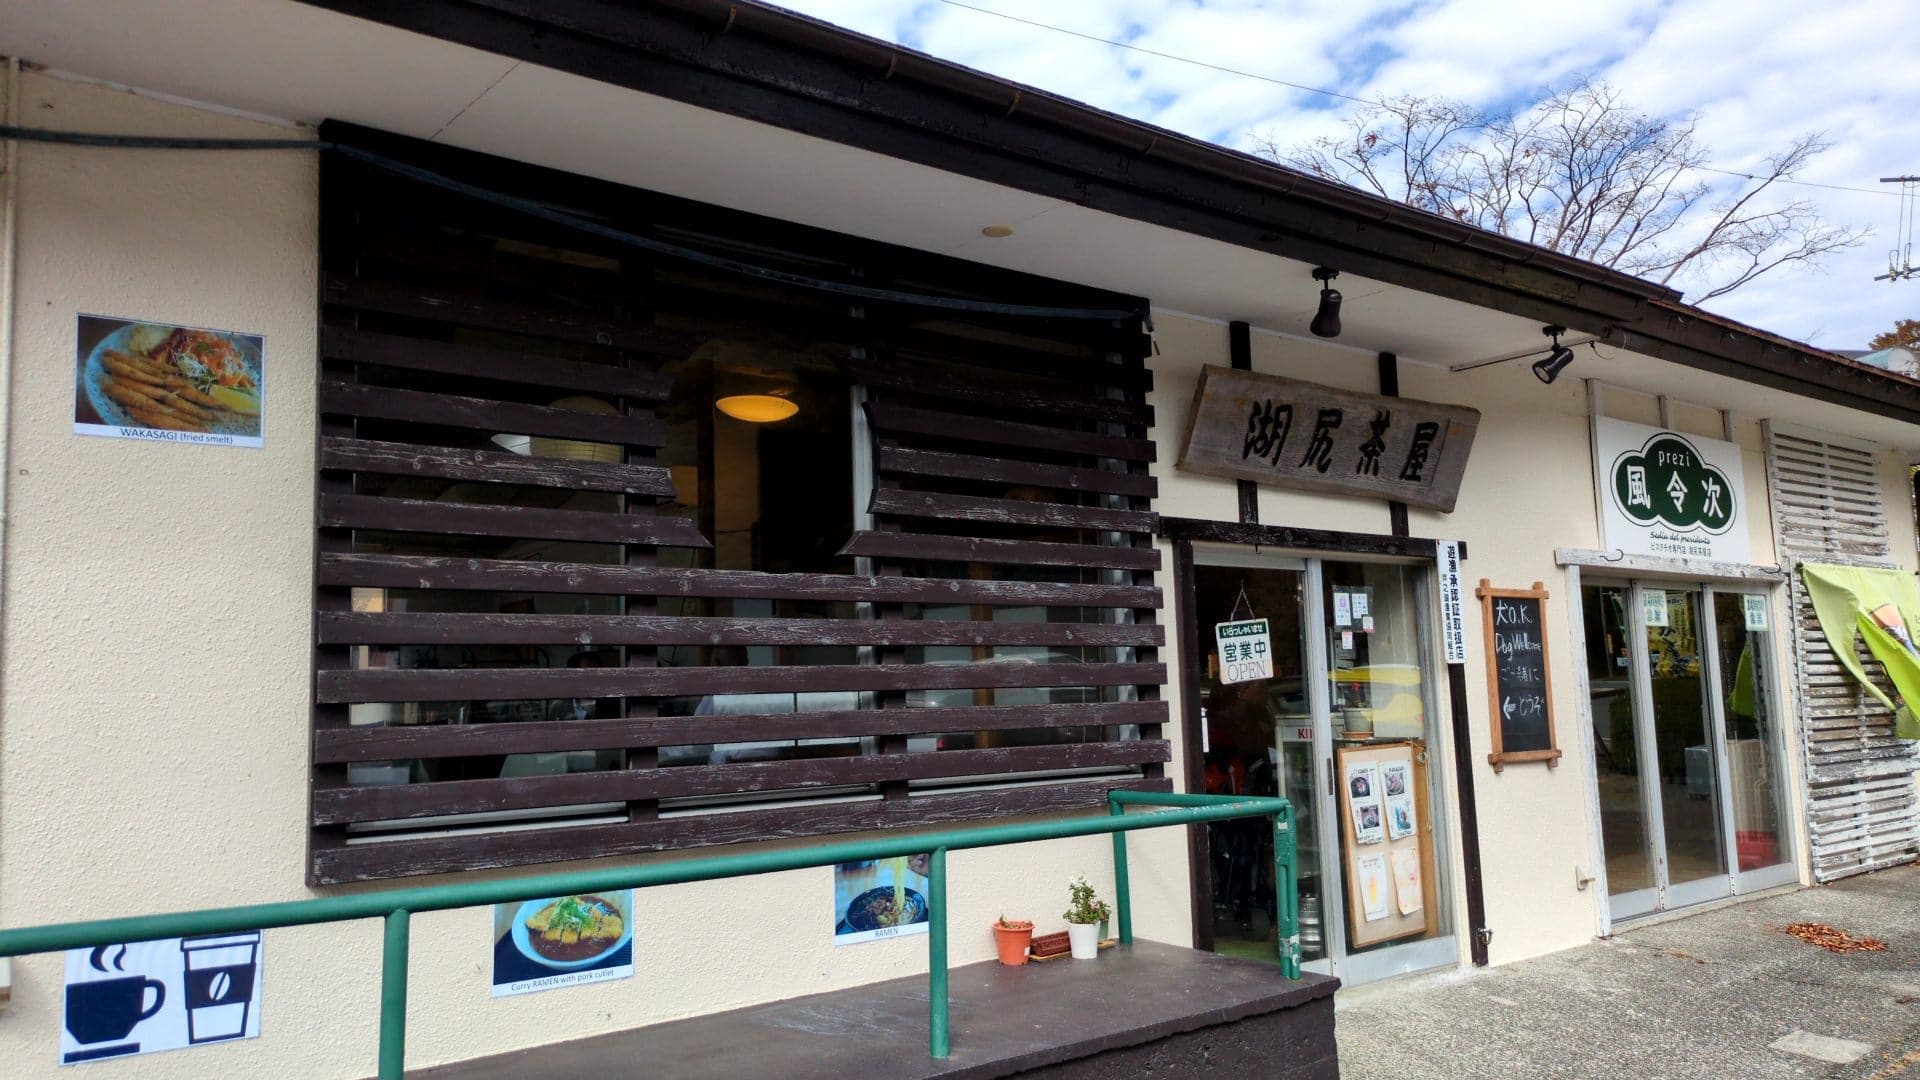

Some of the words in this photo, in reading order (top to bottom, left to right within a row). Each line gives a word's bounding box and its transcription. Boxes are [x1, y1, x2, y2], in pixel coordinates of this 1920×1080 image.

[120, 428, 177, 441] WAKASAGI
[180, 432, 203, 442] (fried
[205, 435, 233, 445] smelt)
[1242, 398, 1440, 482] 湖尻茶屋
[1658, 450, 1690, 467] prezi
[1626, 465, 1724, 518] 風令次
[1222, 624, 1263, 637] いらっしゃいませ
[1224, 639, 1266, 663] 営業中
[1228, 660, 1267, 681] OPEN
[875, 927, 899, 939] RAMEN
[511, 982, 533, 992] Curry
[533, 978, 560, 989] RAMEN
[561, 974, 576, 984] with
[577, 972, 593, 983] pork
[594, 969, 614, 979] cutlet
